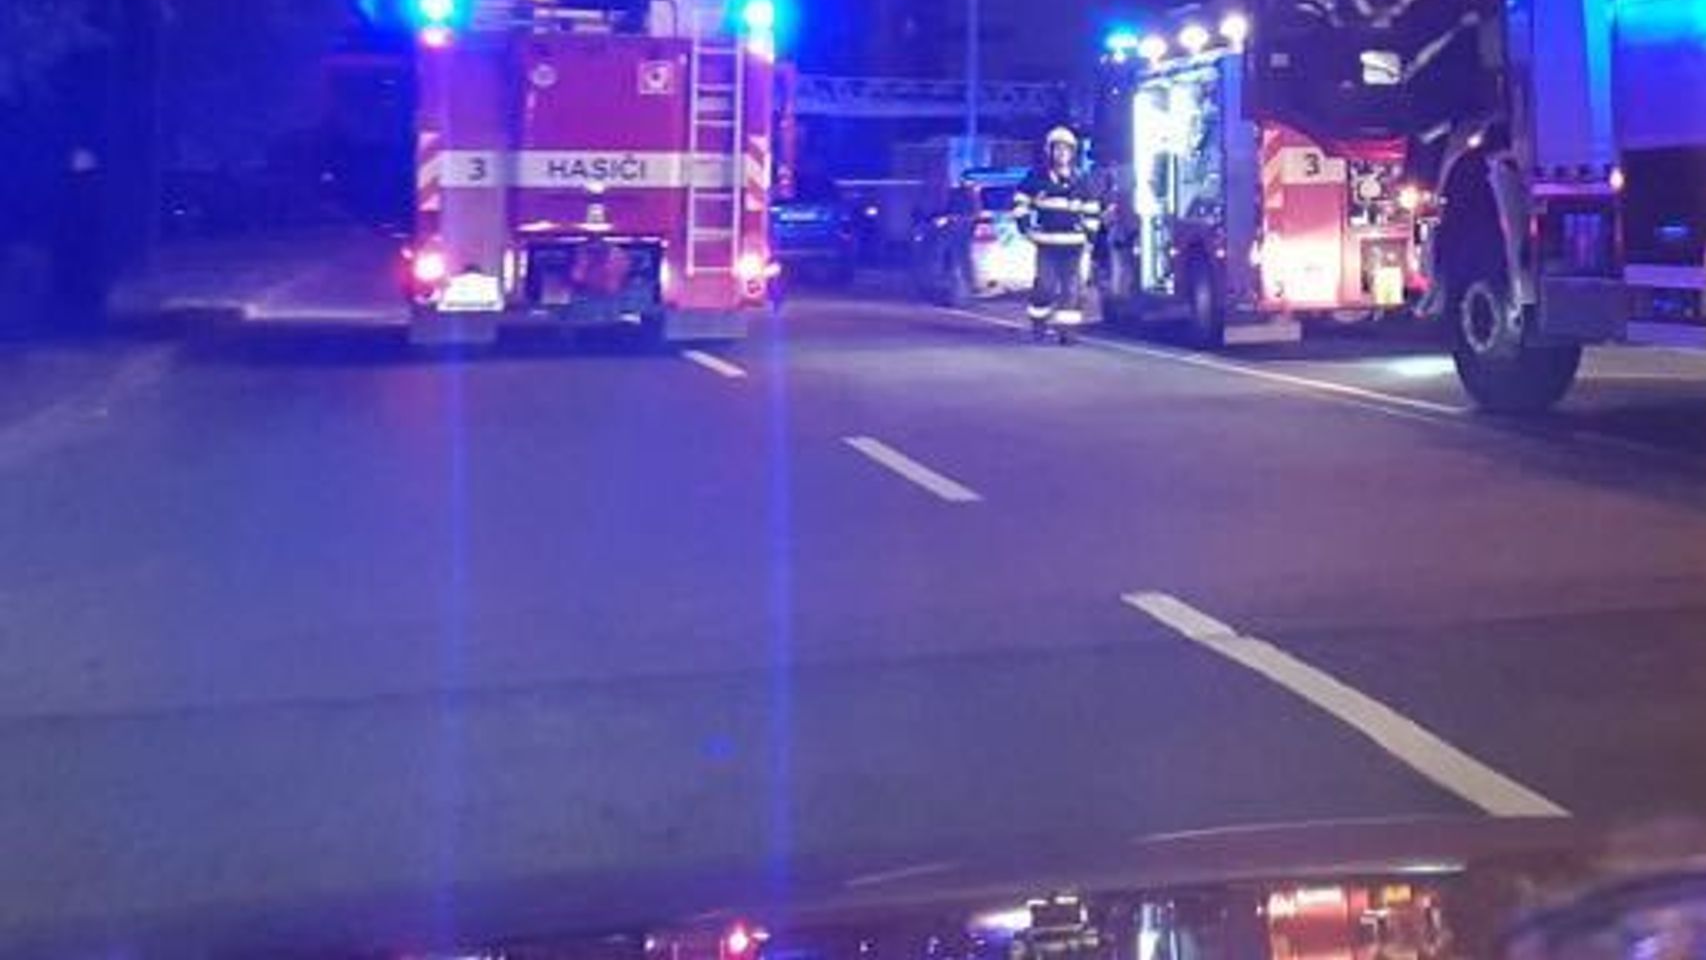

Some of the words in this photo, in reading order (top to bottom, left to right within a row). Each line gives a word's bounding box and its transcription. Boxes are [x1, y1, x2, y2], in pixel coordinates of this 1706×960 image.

[468, 156, 487, 181] 3
[547, 154, 646, 181] HASIČI
[1304, 152, 1320, 177] 3
